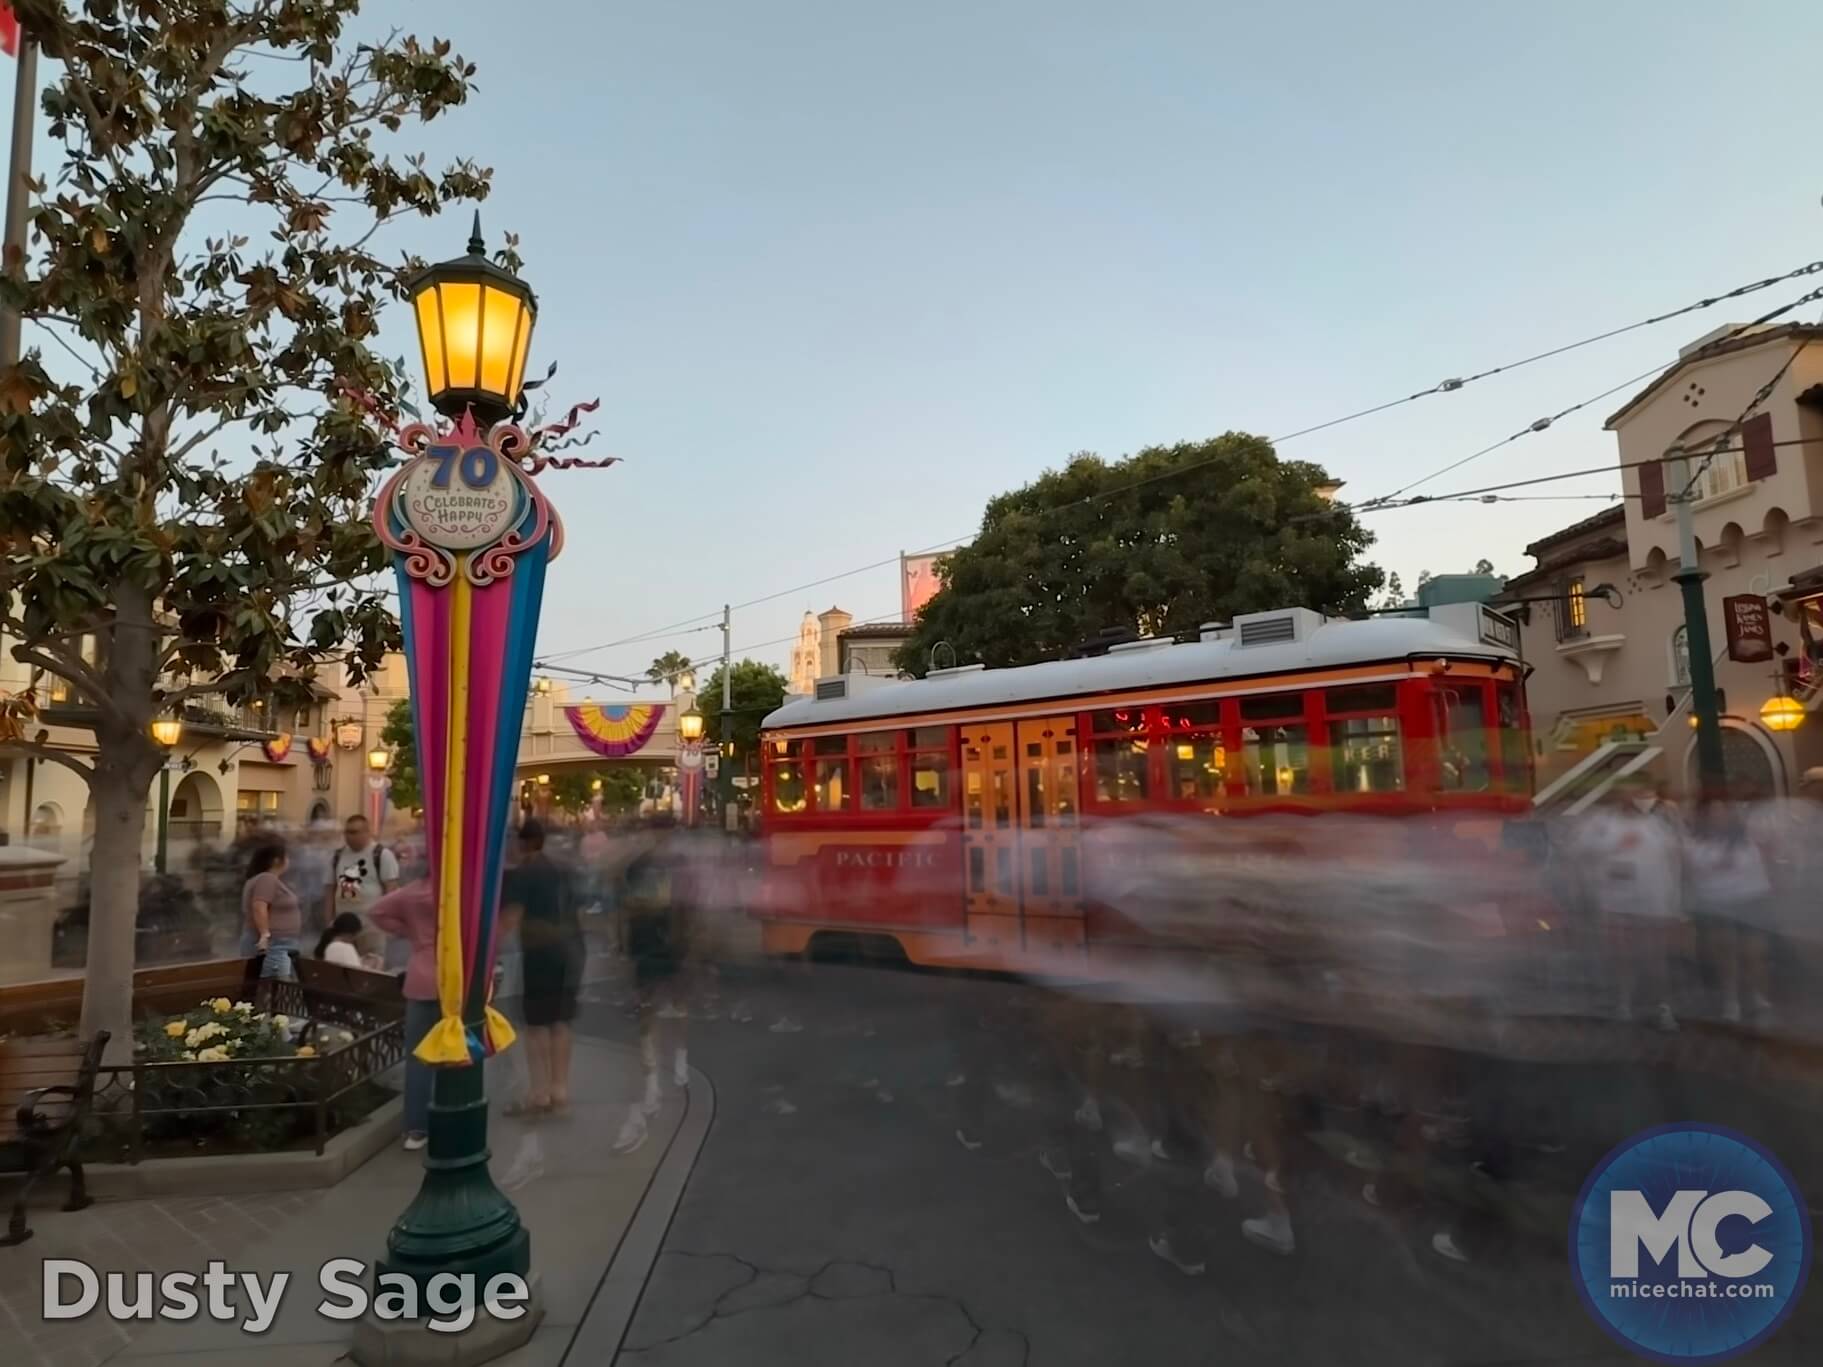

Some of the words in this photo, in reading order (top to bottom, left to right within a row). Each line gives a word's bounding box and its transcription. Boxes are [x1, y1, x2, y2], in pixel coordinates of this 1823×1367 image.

[424, 445, 499, 491] 70
[423, 495, 497, 514] CELEBRATE
[437, 509, 484, 524] HAPPY
[836, 850, 938, 867] PACIFIC
